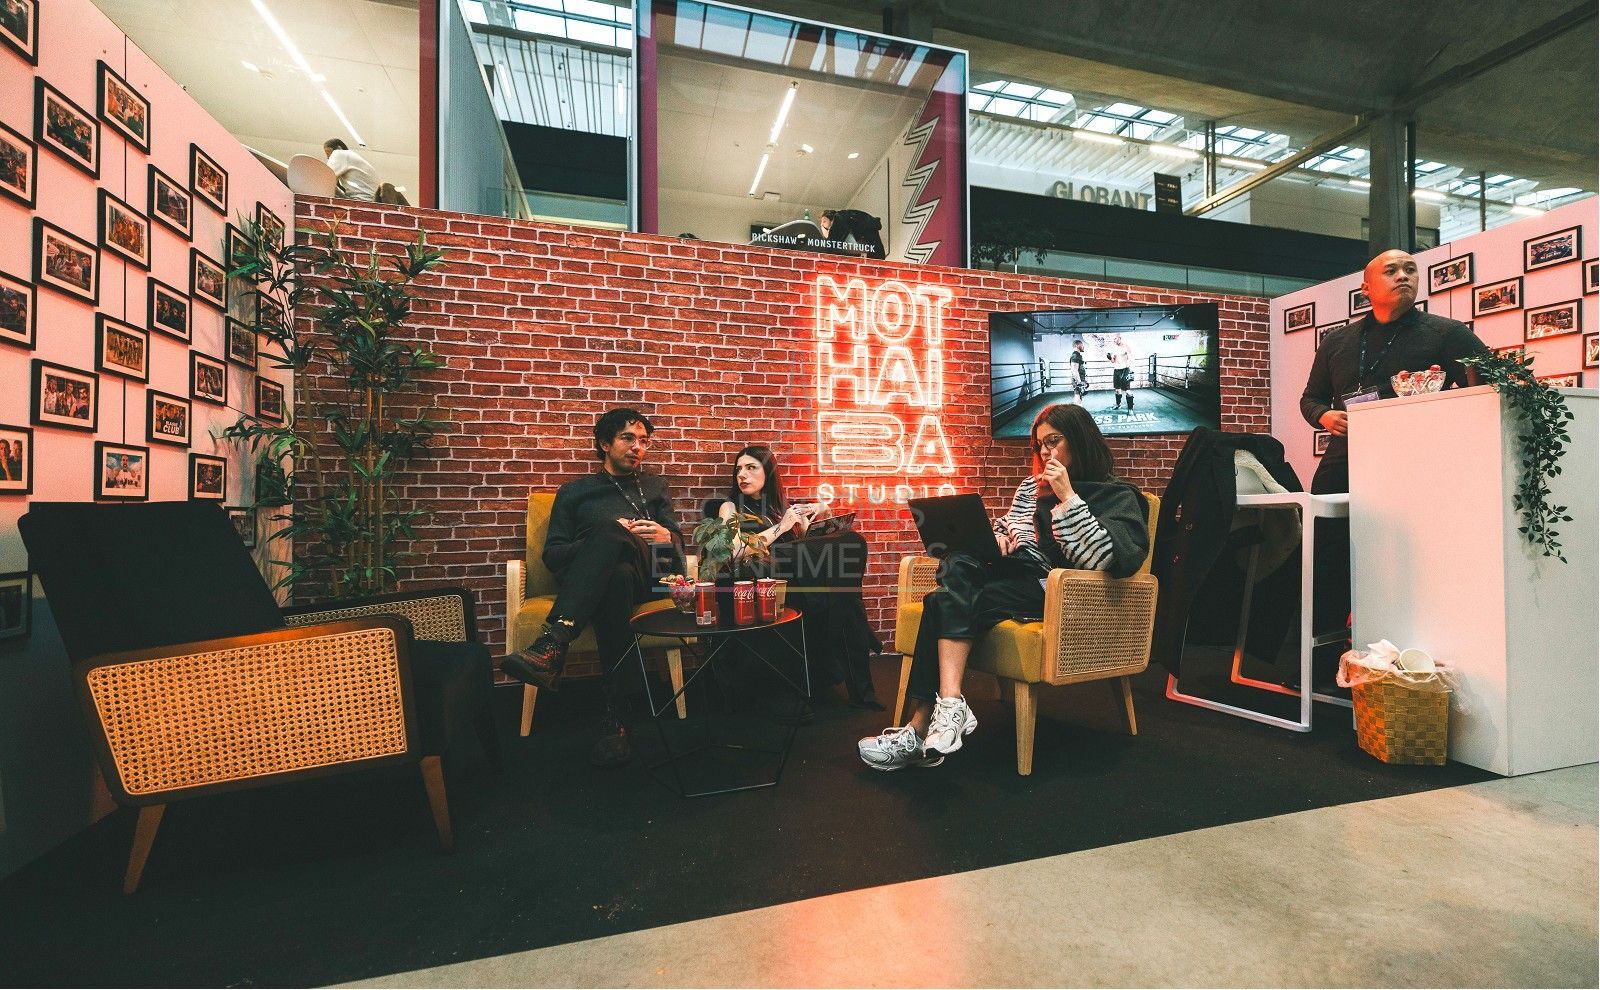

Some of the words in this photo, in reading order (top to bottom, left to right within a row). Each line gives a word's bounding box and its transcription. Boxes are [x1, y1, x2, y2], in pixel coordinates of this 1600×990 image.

[751, 233, 797, 245] RICKSHAW
[807, 238, 876, 253] MONSTERTRUCK
[816, 275, 953, 345] MOT
[816, 342, 942, 407] HAI
[1117, 412, 1159, 423] PARK
[162, 424, 180, 435] CLUB
[817, 411, 955, 474] BA
[816, 483, 957, 505] STUDIO
